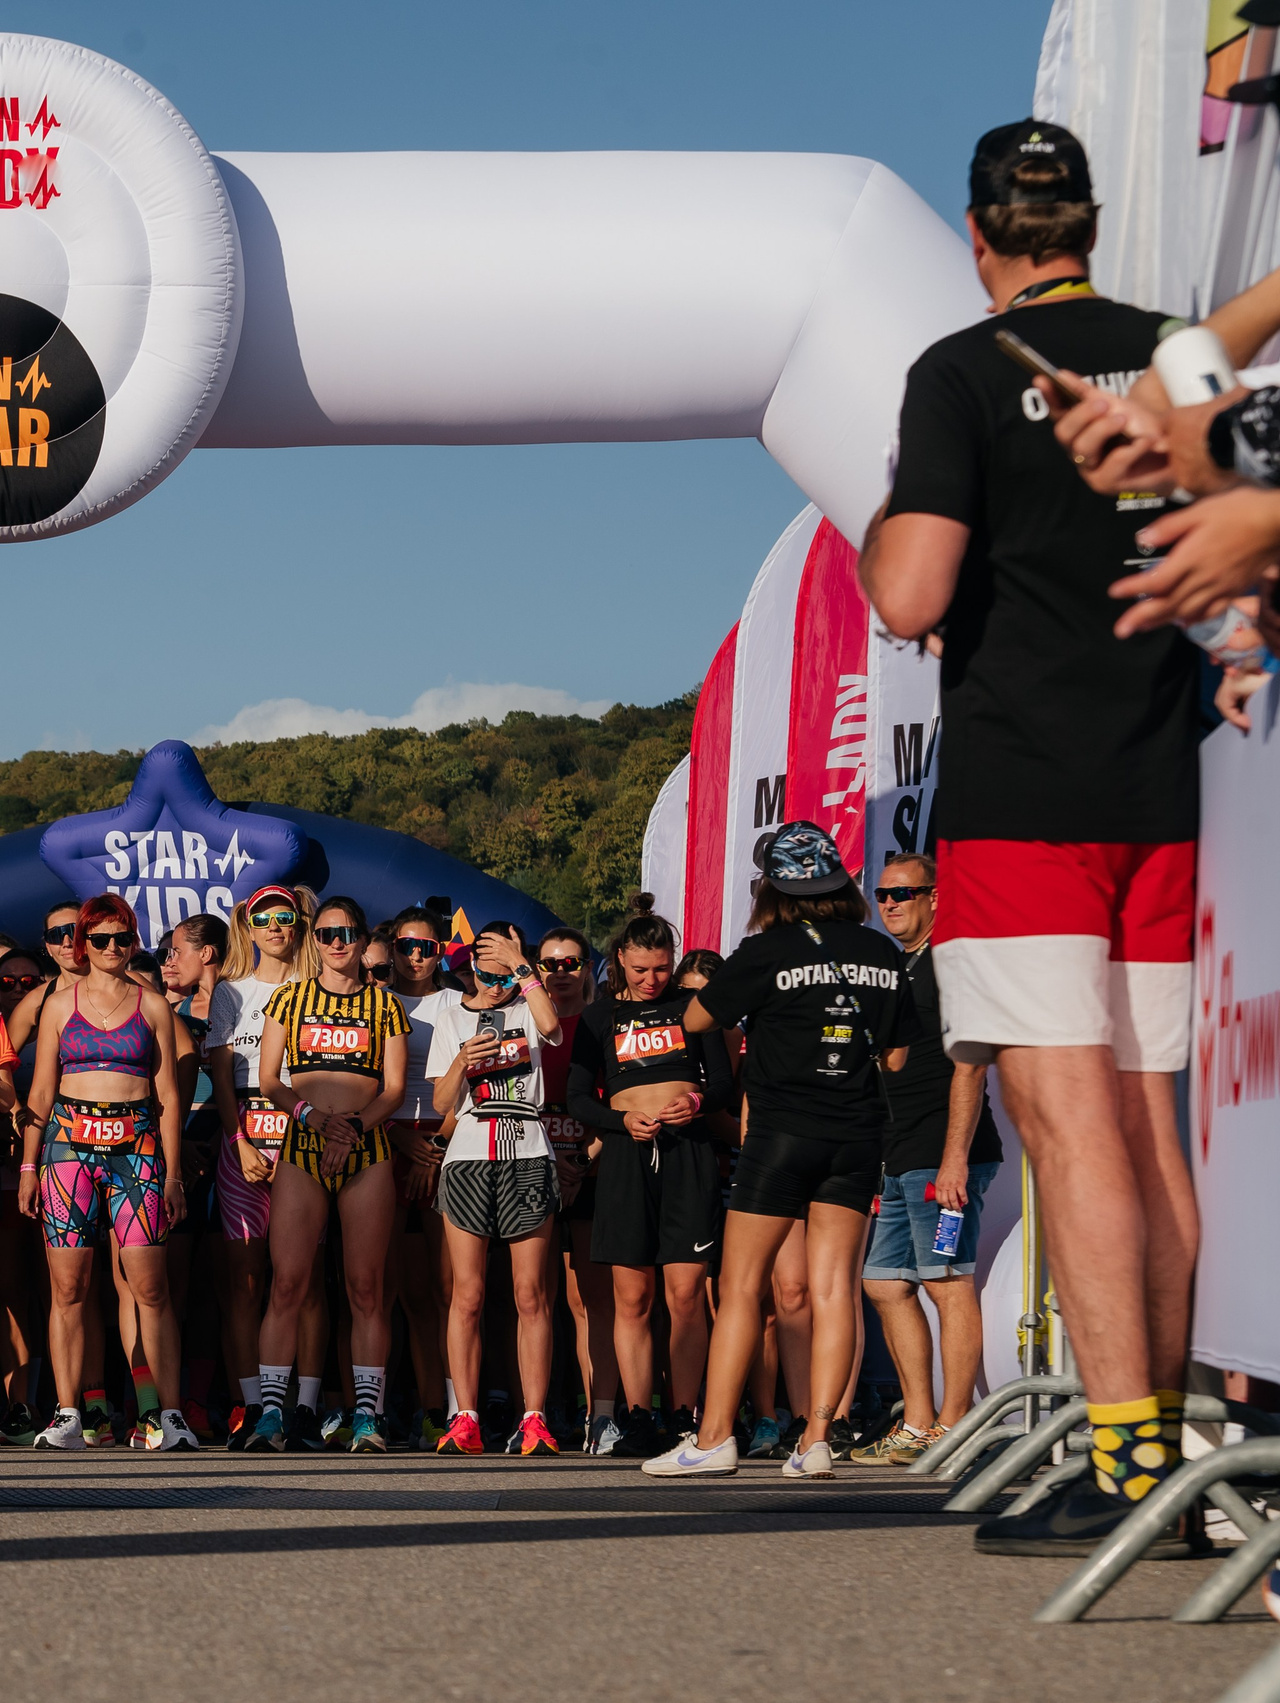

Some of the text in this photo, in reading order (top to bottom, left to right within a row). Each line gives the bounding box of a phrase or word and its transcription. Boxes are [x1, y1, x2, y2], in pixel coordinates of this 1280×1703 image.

[104, 830, 209, 880] STAR
[234, 1032, 263, 1048] trisy
[310, 1027, 359, 1049] 7300
[627, 1029, 673, 1055] 7061
[321, 1053, 346, 1061] ТАТЬЯНА
[82, 1118, 125, 1141] 7159
[253, 1114, 288, 1134] 780
[541, 1117, 585, 1138] 7365
